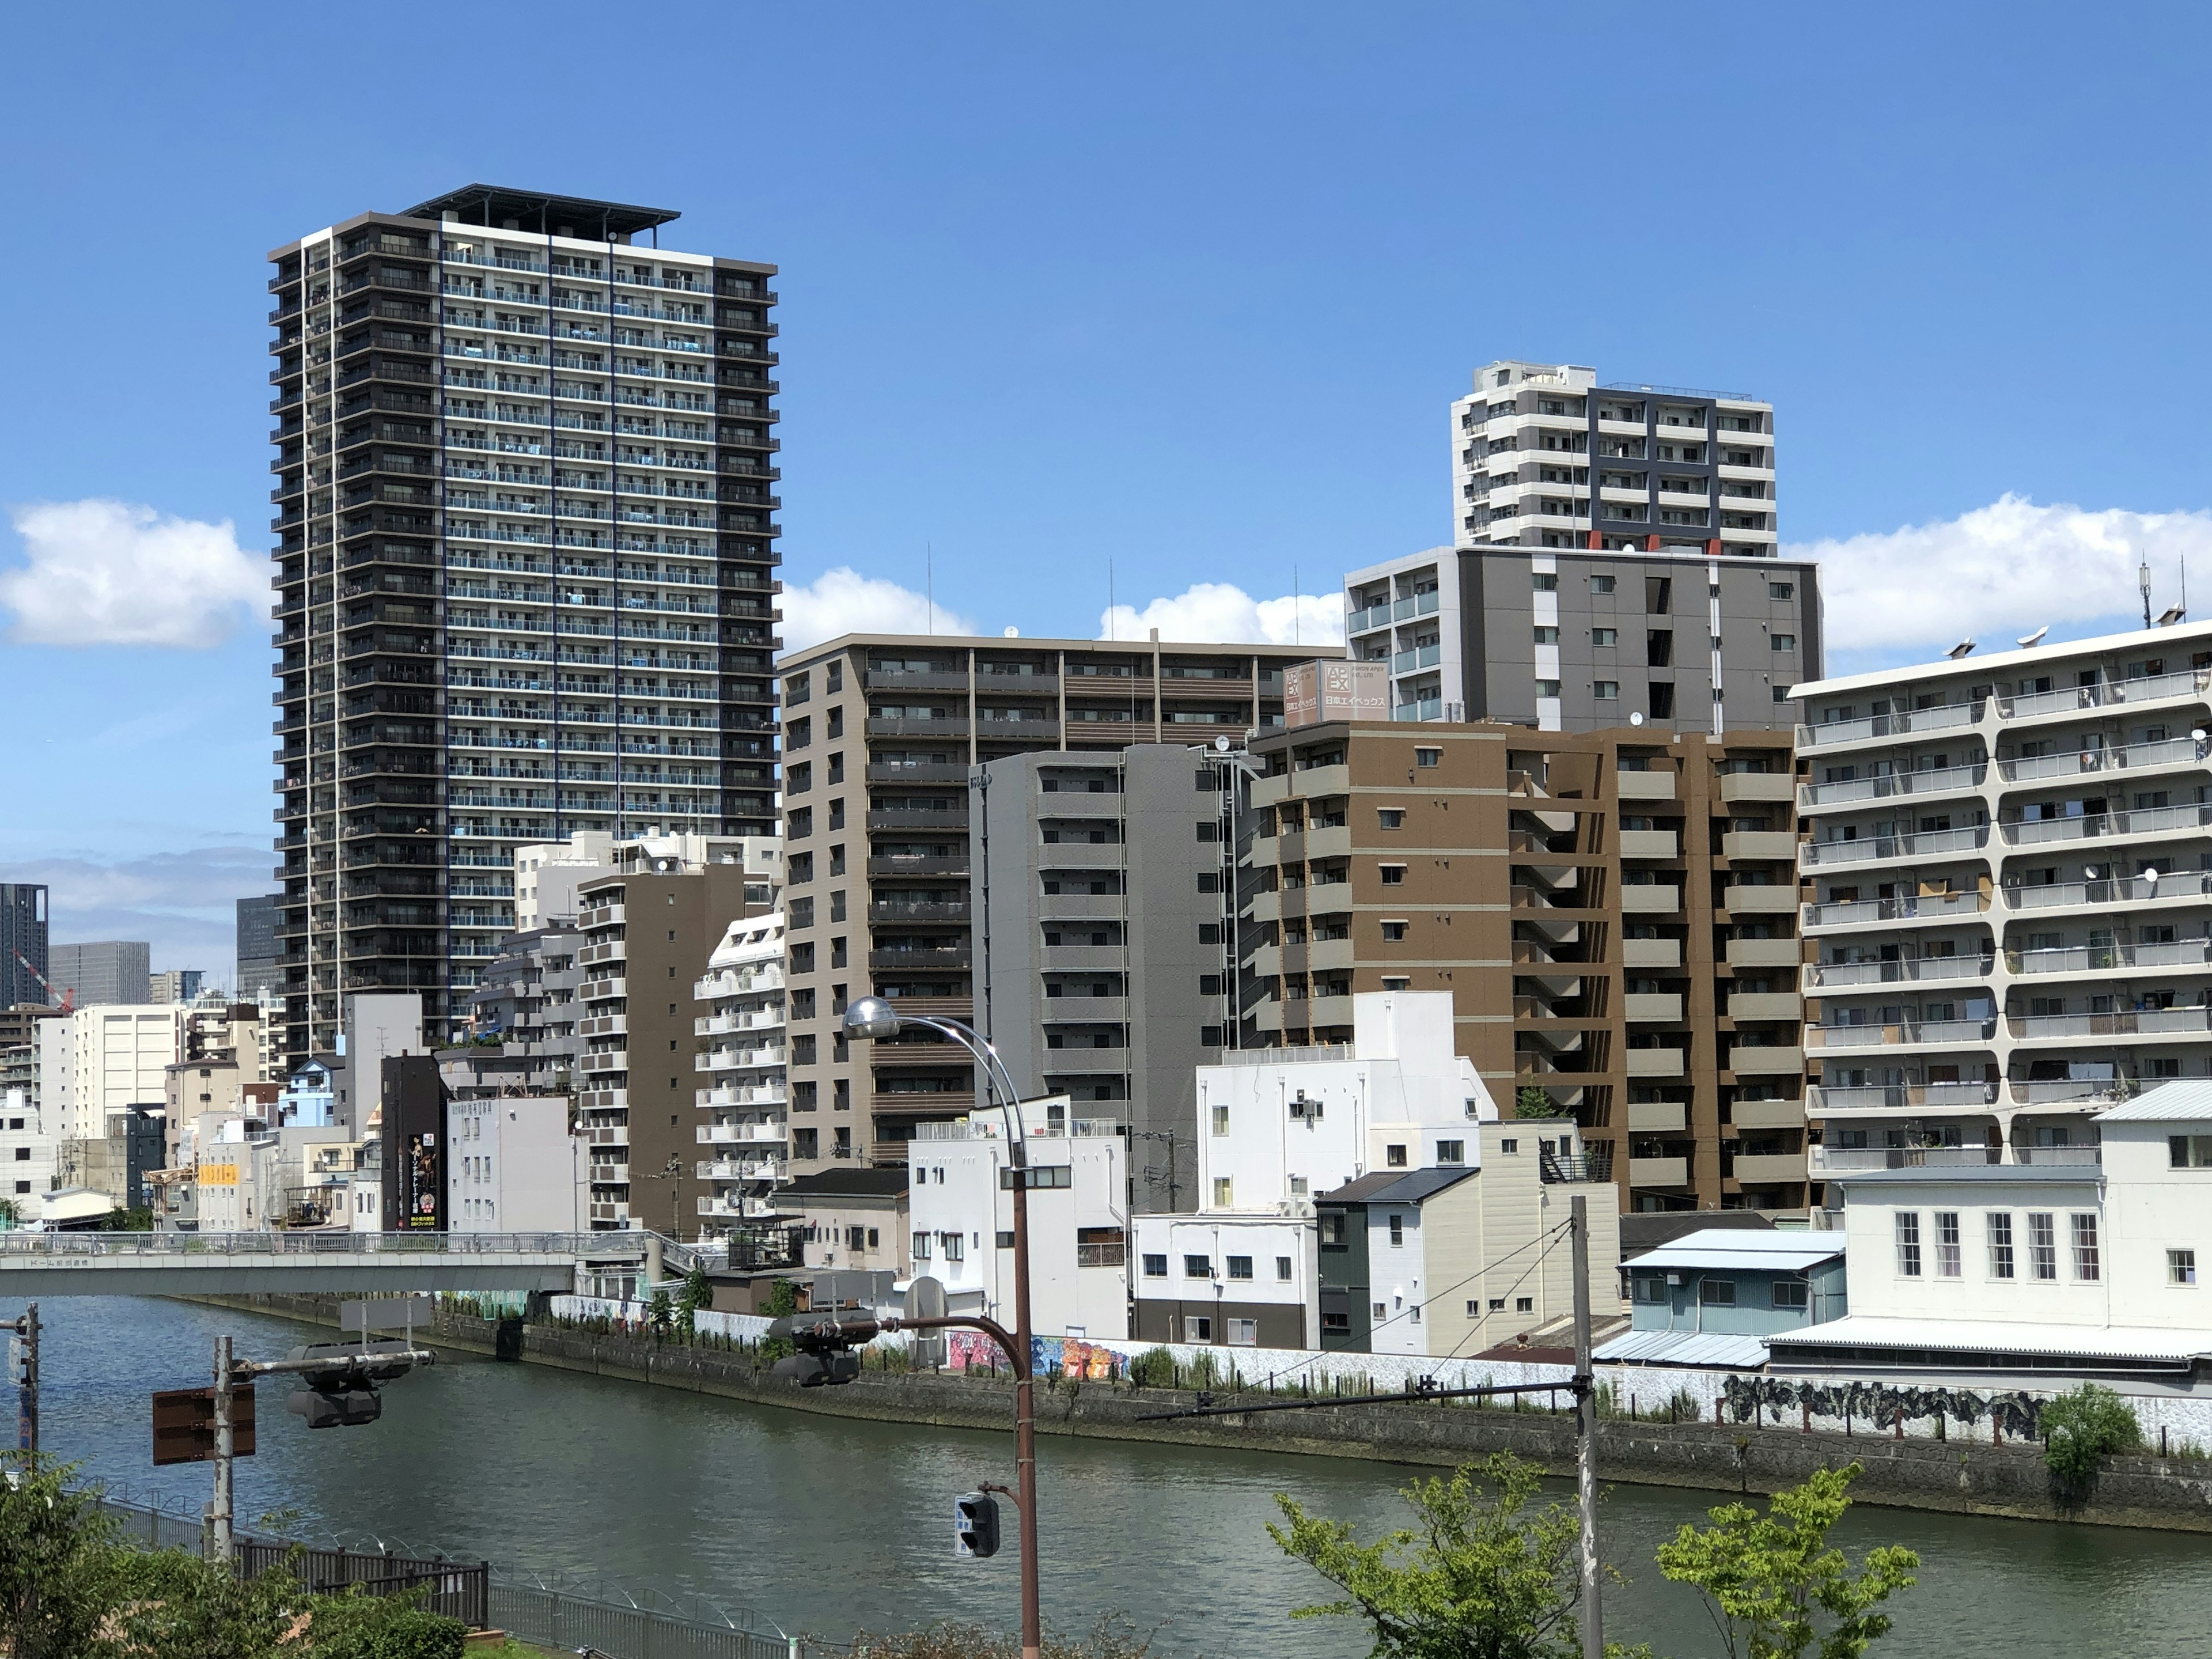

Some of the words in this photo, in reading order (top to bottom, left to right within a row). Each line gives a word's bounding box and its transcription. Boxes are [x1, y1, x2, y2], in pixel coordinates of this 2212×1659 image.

[1325, 696, 1385, 706] 日本エイペックス
[20, 1390, 31, 1464] 歩車分離
